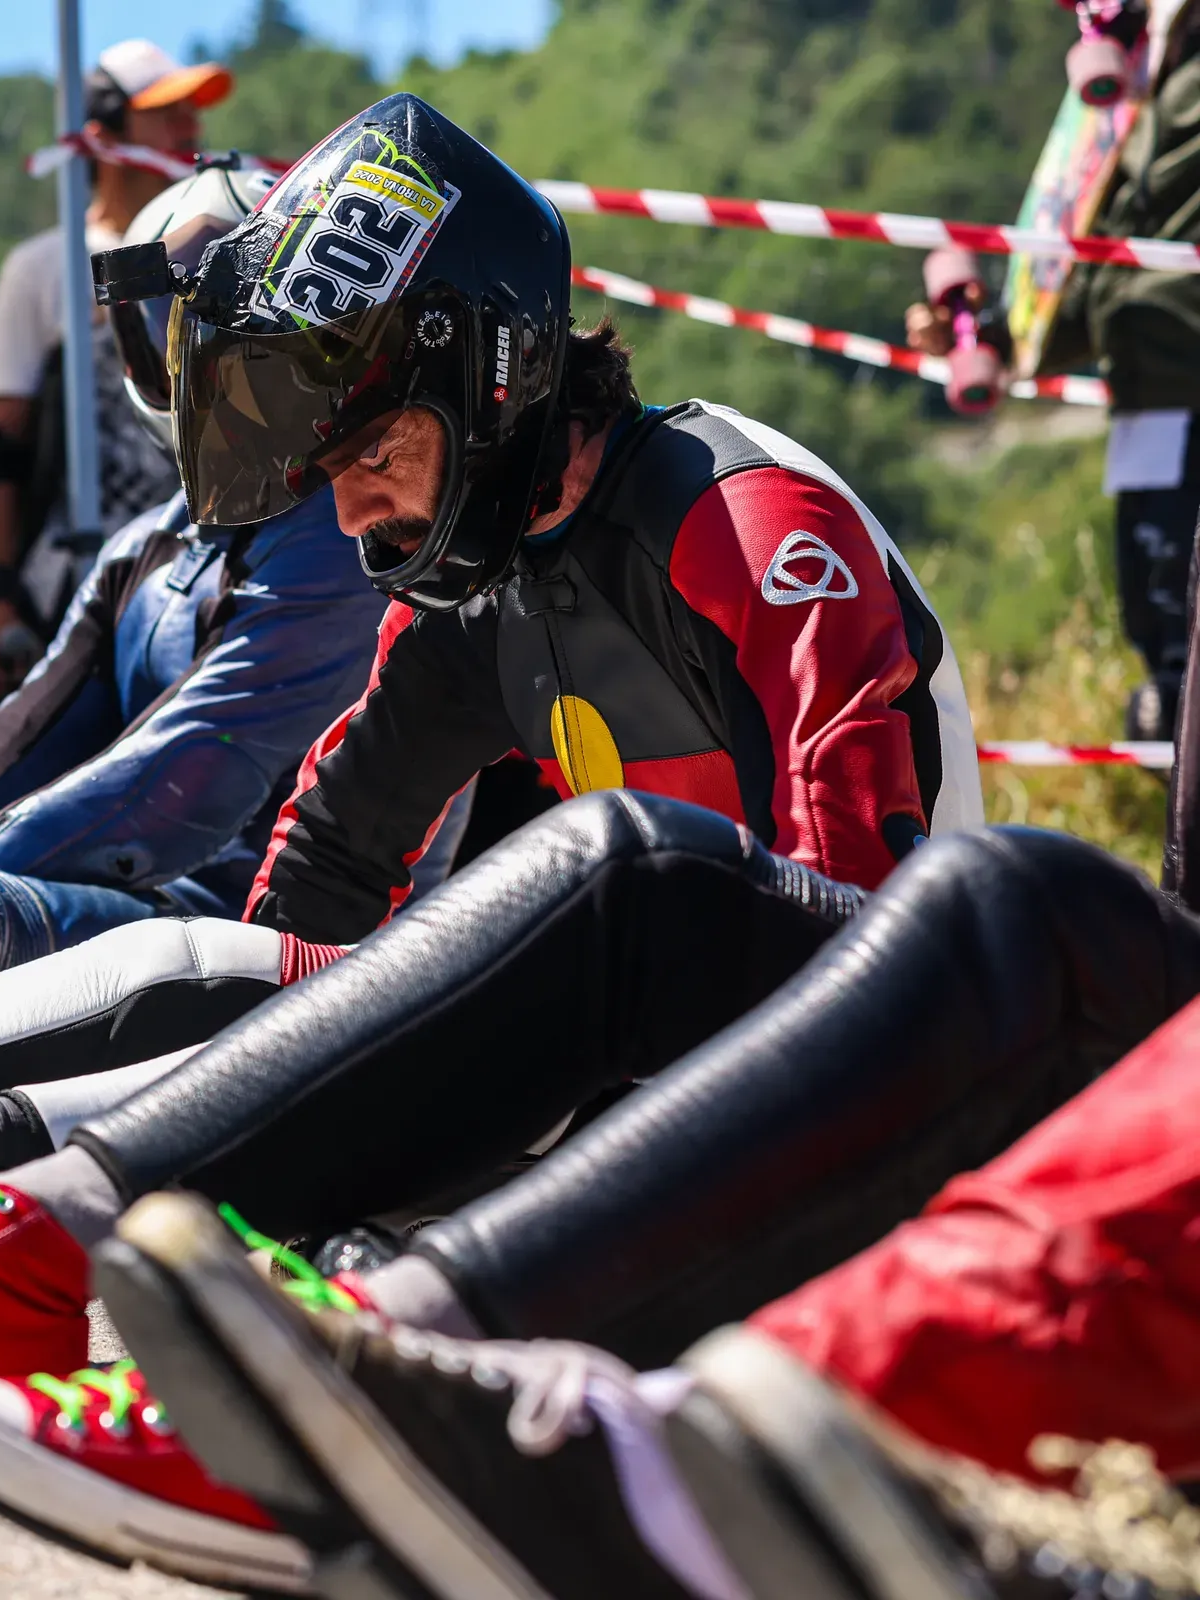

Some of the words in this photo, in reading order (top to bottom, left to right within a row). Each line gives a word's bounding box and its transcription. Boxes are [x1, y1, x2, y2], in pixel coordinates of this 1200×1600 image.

[353, 168, 383, 185] 2022
[383, 178, 420, 205] TRONA
[418, 197, 437, 213] LA
[284, 192, 421, 336] 202
[416, 318, 436, 348] TRIPLE
[434, 311, 453, 341] EIGHT
[495, 325, 510, 386] RACER
